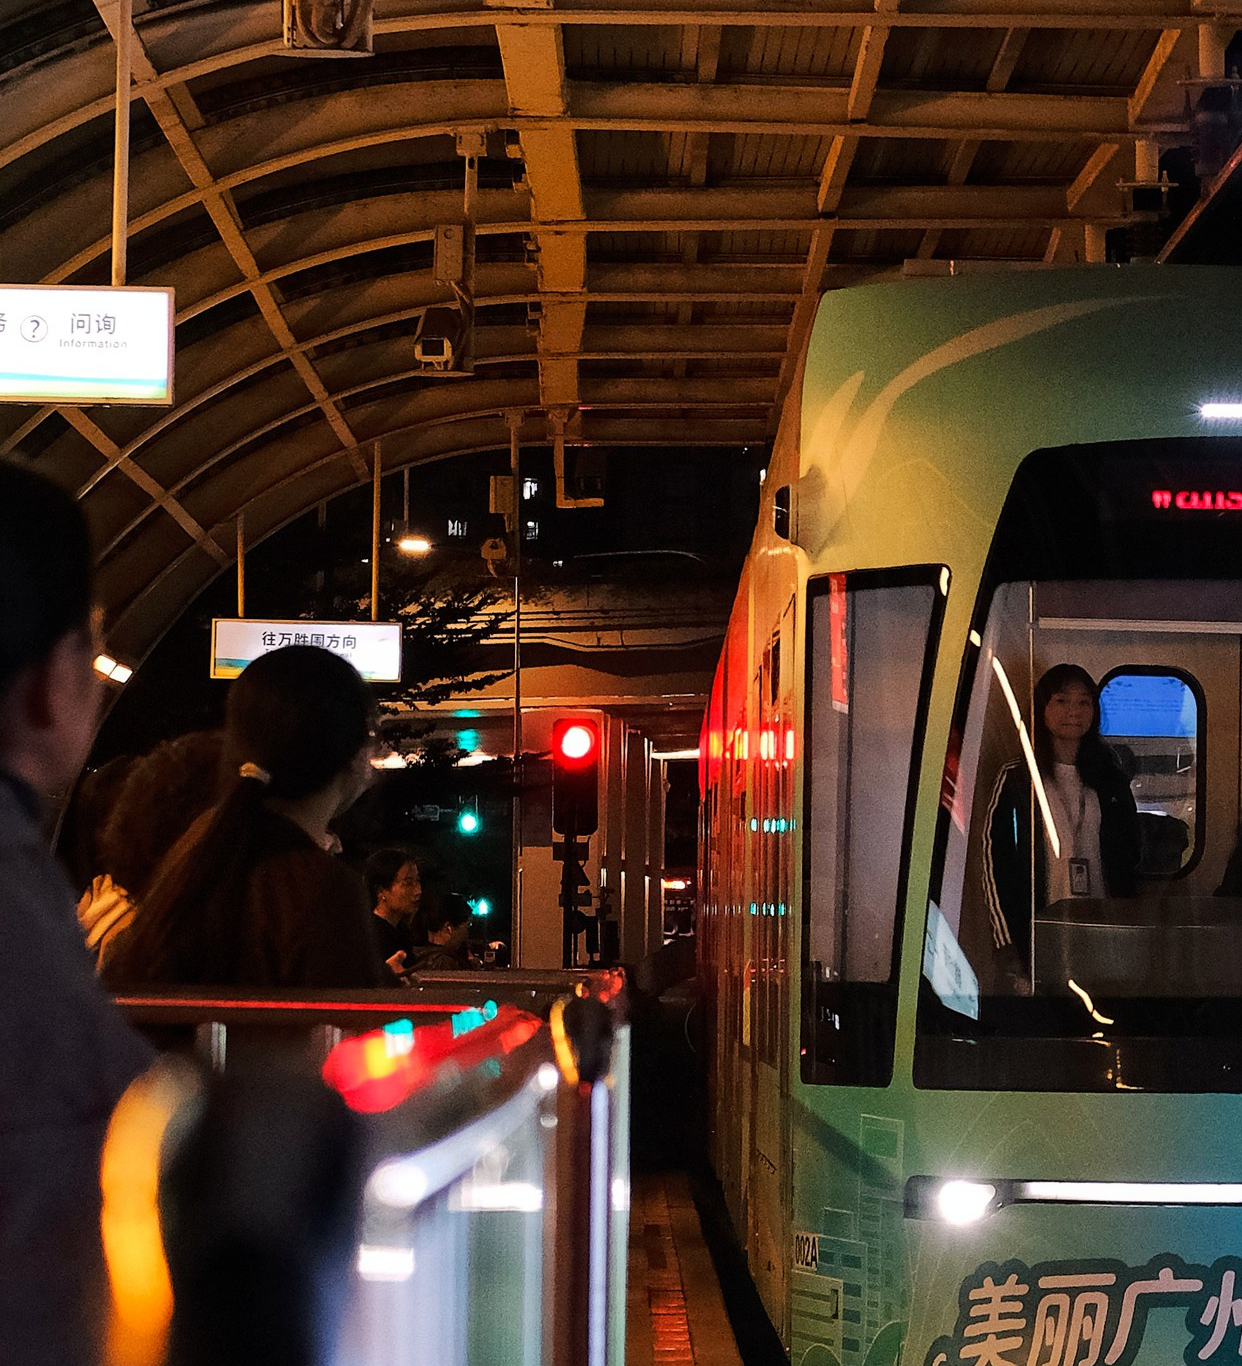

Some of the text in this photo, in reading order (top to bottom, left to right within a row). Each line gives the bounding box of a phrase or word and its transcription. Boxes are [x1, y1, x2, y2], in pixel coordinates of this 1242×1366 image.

[71, 313, 116, 335] 问询
[60, 339, 127, 349] Information
[262, 631, 357, 650] 往万胜围方向
[795, 1234, 818, 1268] 002A
